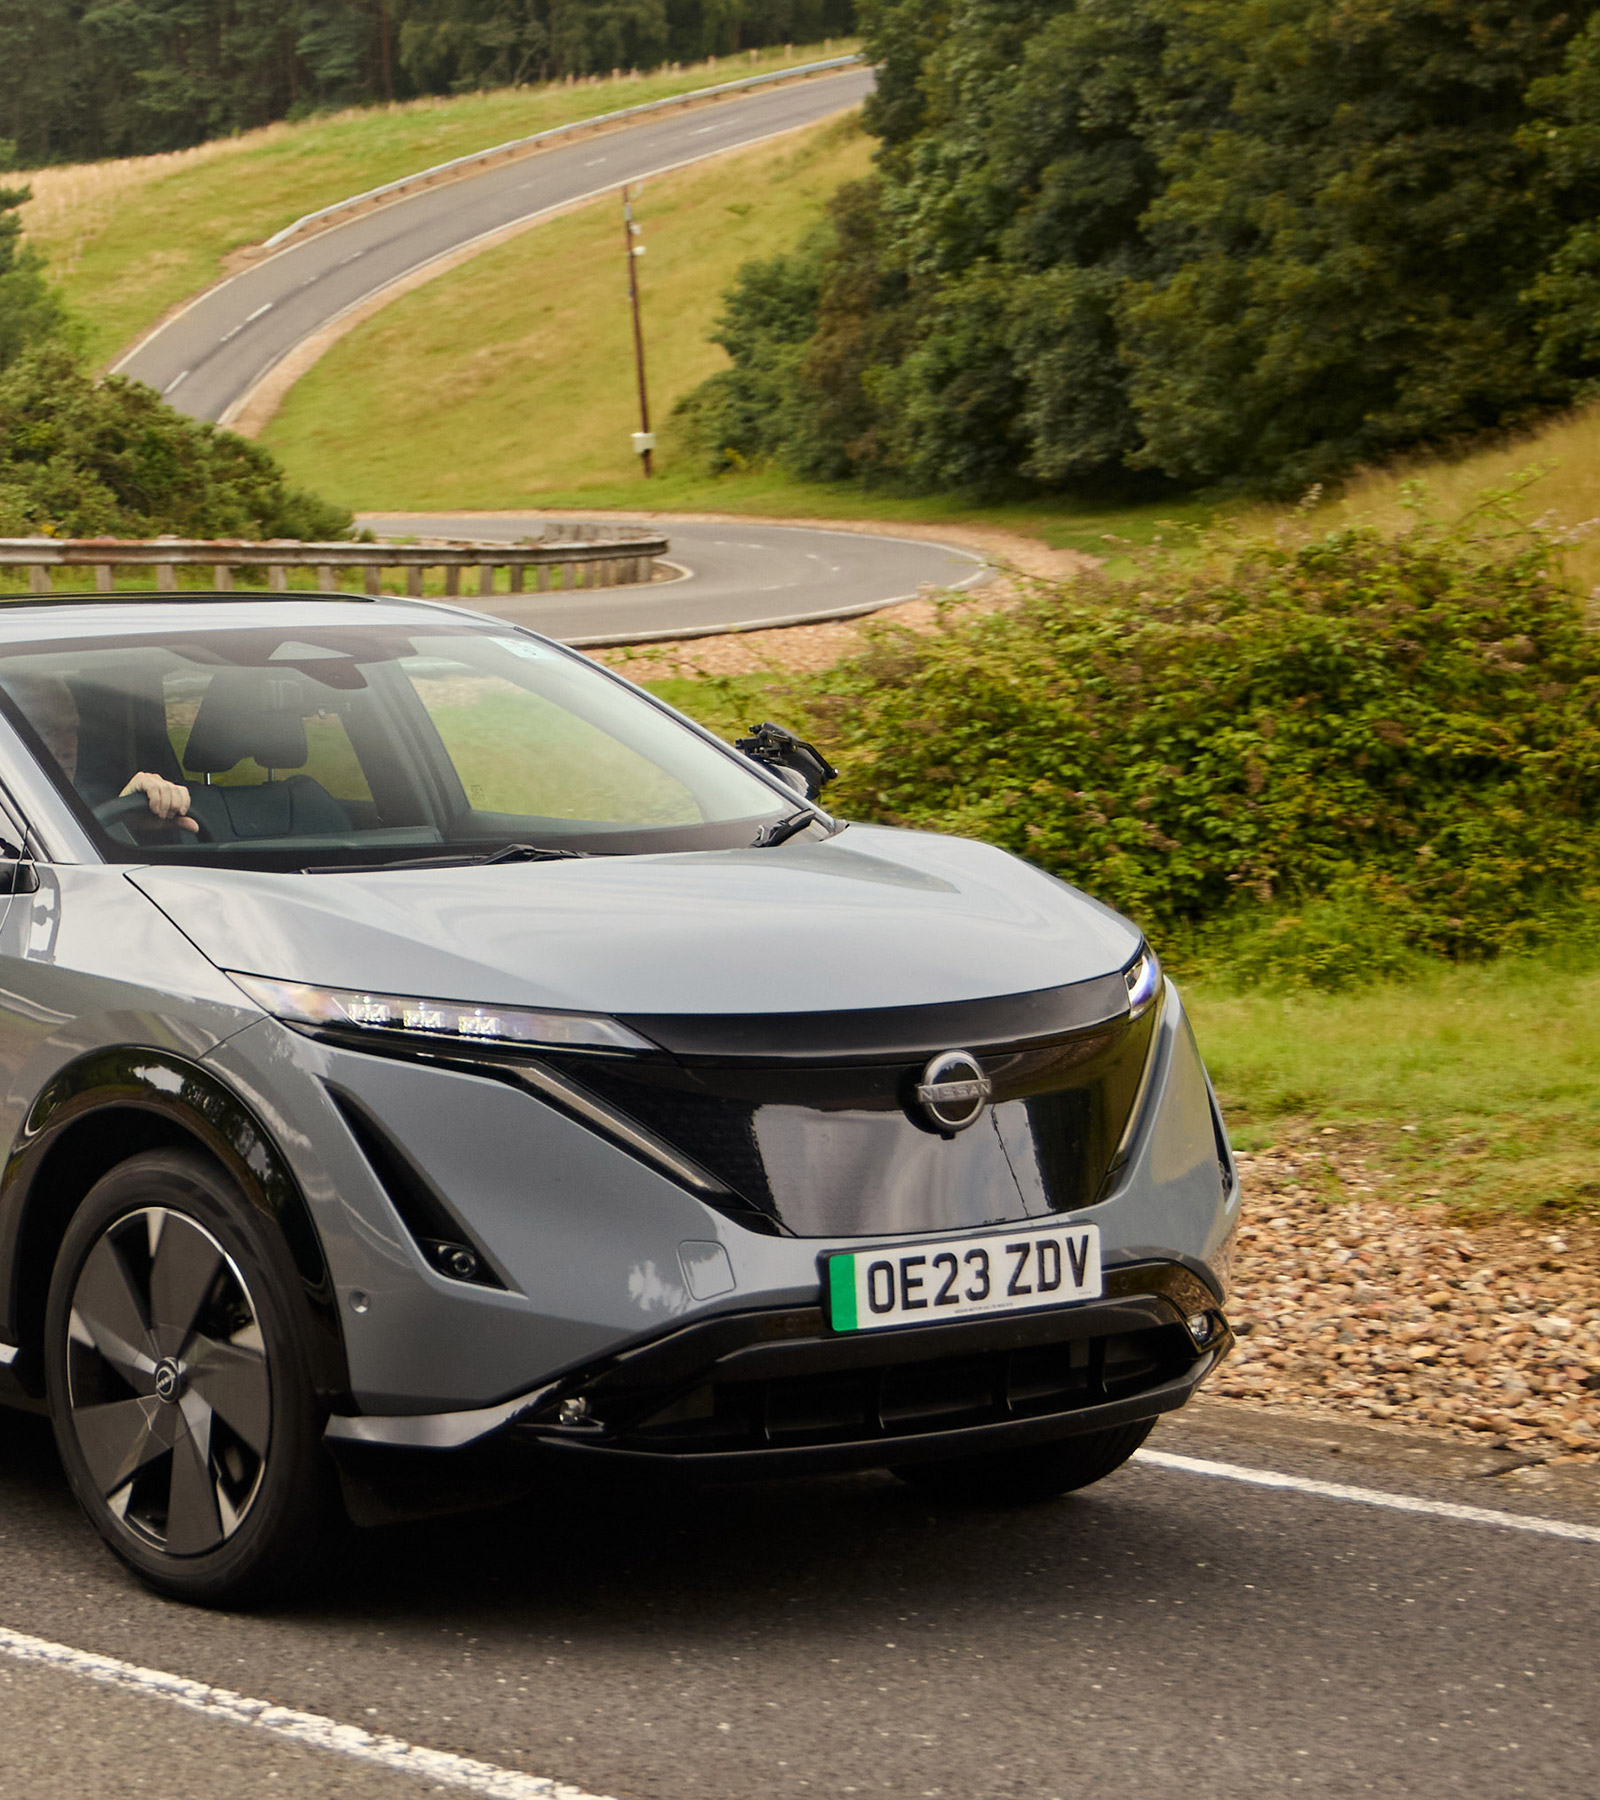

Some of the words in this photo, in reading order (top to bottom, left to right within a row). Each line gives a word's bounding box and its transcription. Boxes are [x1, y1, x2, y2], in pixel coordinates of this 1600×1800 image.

[919, 1081, 992, 1102] NISSAN
[866, 1247, 991, 1315] OE23
[1005, 1234, 1089, 1297] ZDV
